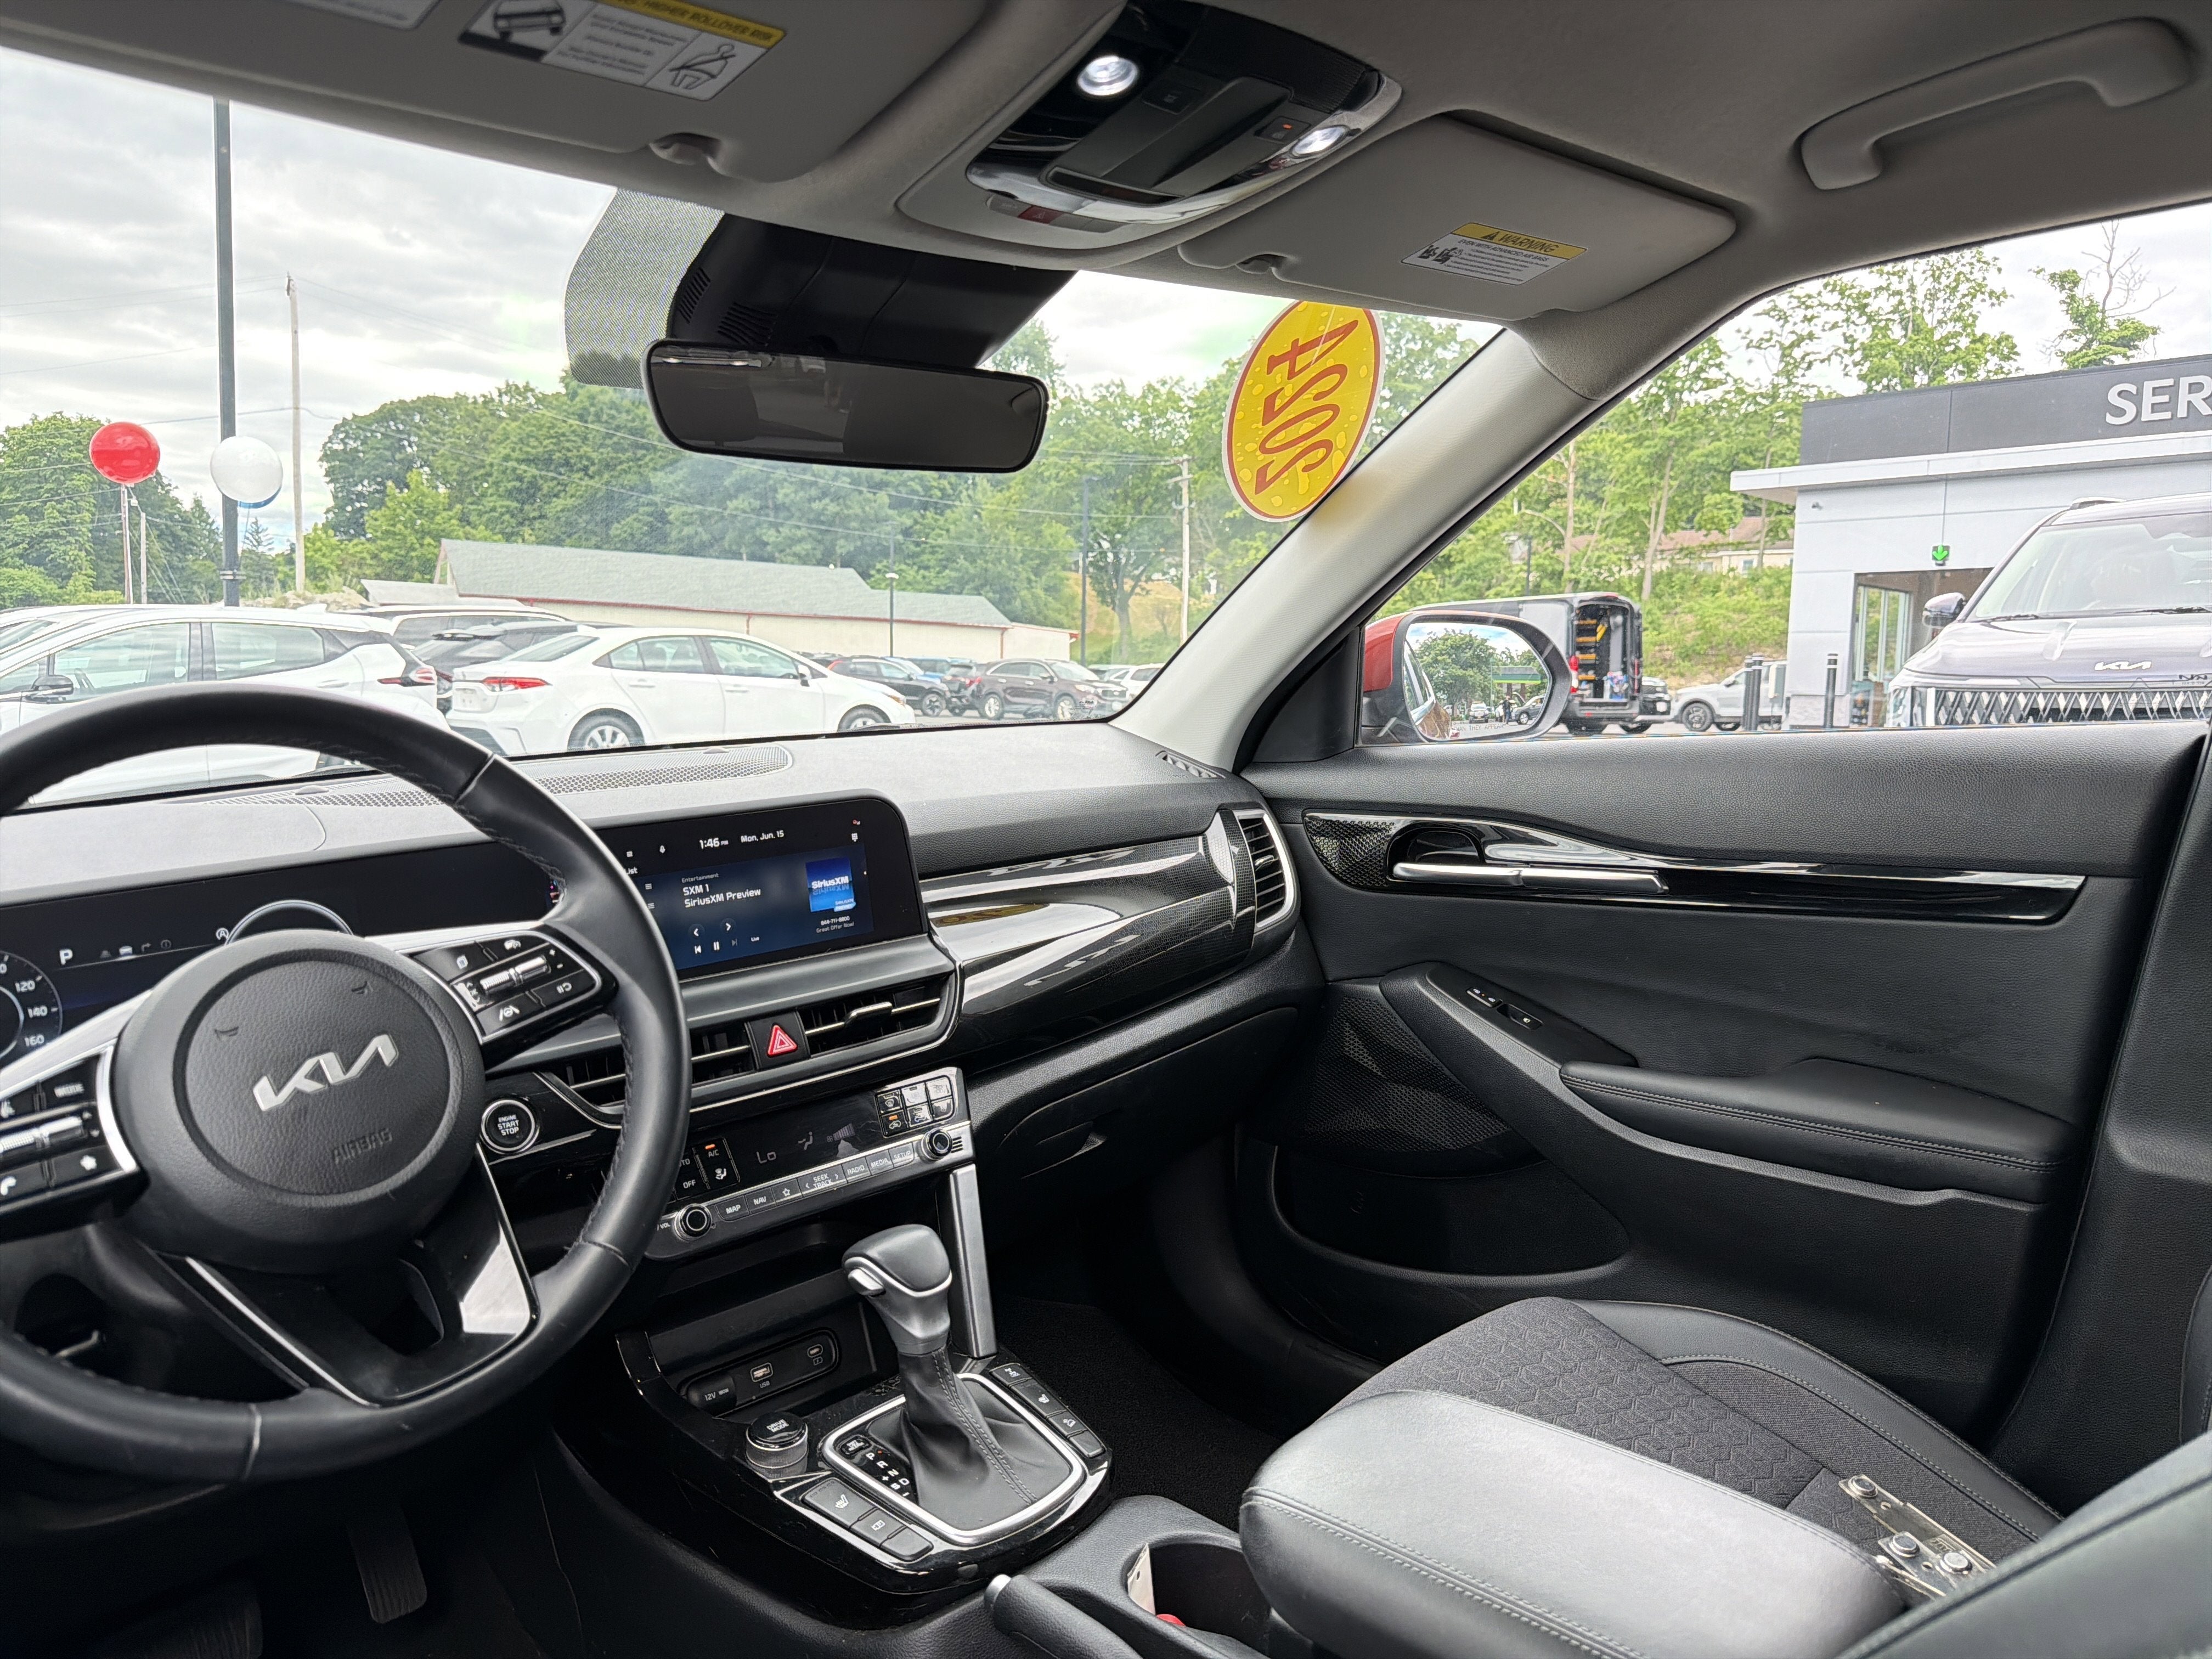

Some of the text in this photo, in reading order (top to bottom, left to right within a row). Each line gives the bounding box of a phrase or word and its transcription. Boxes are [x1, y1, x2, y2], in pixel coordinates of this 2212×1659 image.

[1498, 234, 1559, 252] WARNING
[1491, 246, 1523, 256] ADVANCED
[699, 838, 720, 849] 1:46
[681, 873, 719, 883] Entertainment
[812, 876, 849, 889] SiriusXM
[683, 884, 709, 896] SXM 1
[684, 889, 761, 908] SiriusXM Preview
[59, 949, 73, 965] P
[15, 980, 35, 992] 120
[28, 1005, 48, 1019] 140
[24, 1035, 44, 1047] 160
[253, 1034, 398, 1111] KIA
[498, 1114, 517, 1122] ENGINE
[498, 1120, 520, 1130] START
[501, 1127, 520, 1136] STOP
[333, 1128, 393, 1165] AIRBAG
[708, 1149, 720, 1158] A/C
[894, 1150, 912, 1160] SETUP
[871, 1157, 889, 1168] MEDIA
[847, 1165, 865, 1175] RADIO
[813, 1173, 829, 1183] SEEK
[682, 1180, 696, 1189] OFF
[813, 1179, 833, 1189] TRACK
[753, 1196, 766, 1205] NAV
[726, 1204, 741, 1214] MAP
[760, 1380, 770, 1389] USB
[704, 1392, 716, 1401] 12V
[766, 1419, 786, 1430] DRIVE
[771, 1423, 789, 1433] MODE
[866, 1452, 875, 1460] P
[876, 1460, 889, 1469] R
[888, 1469, 899, 1477] N
